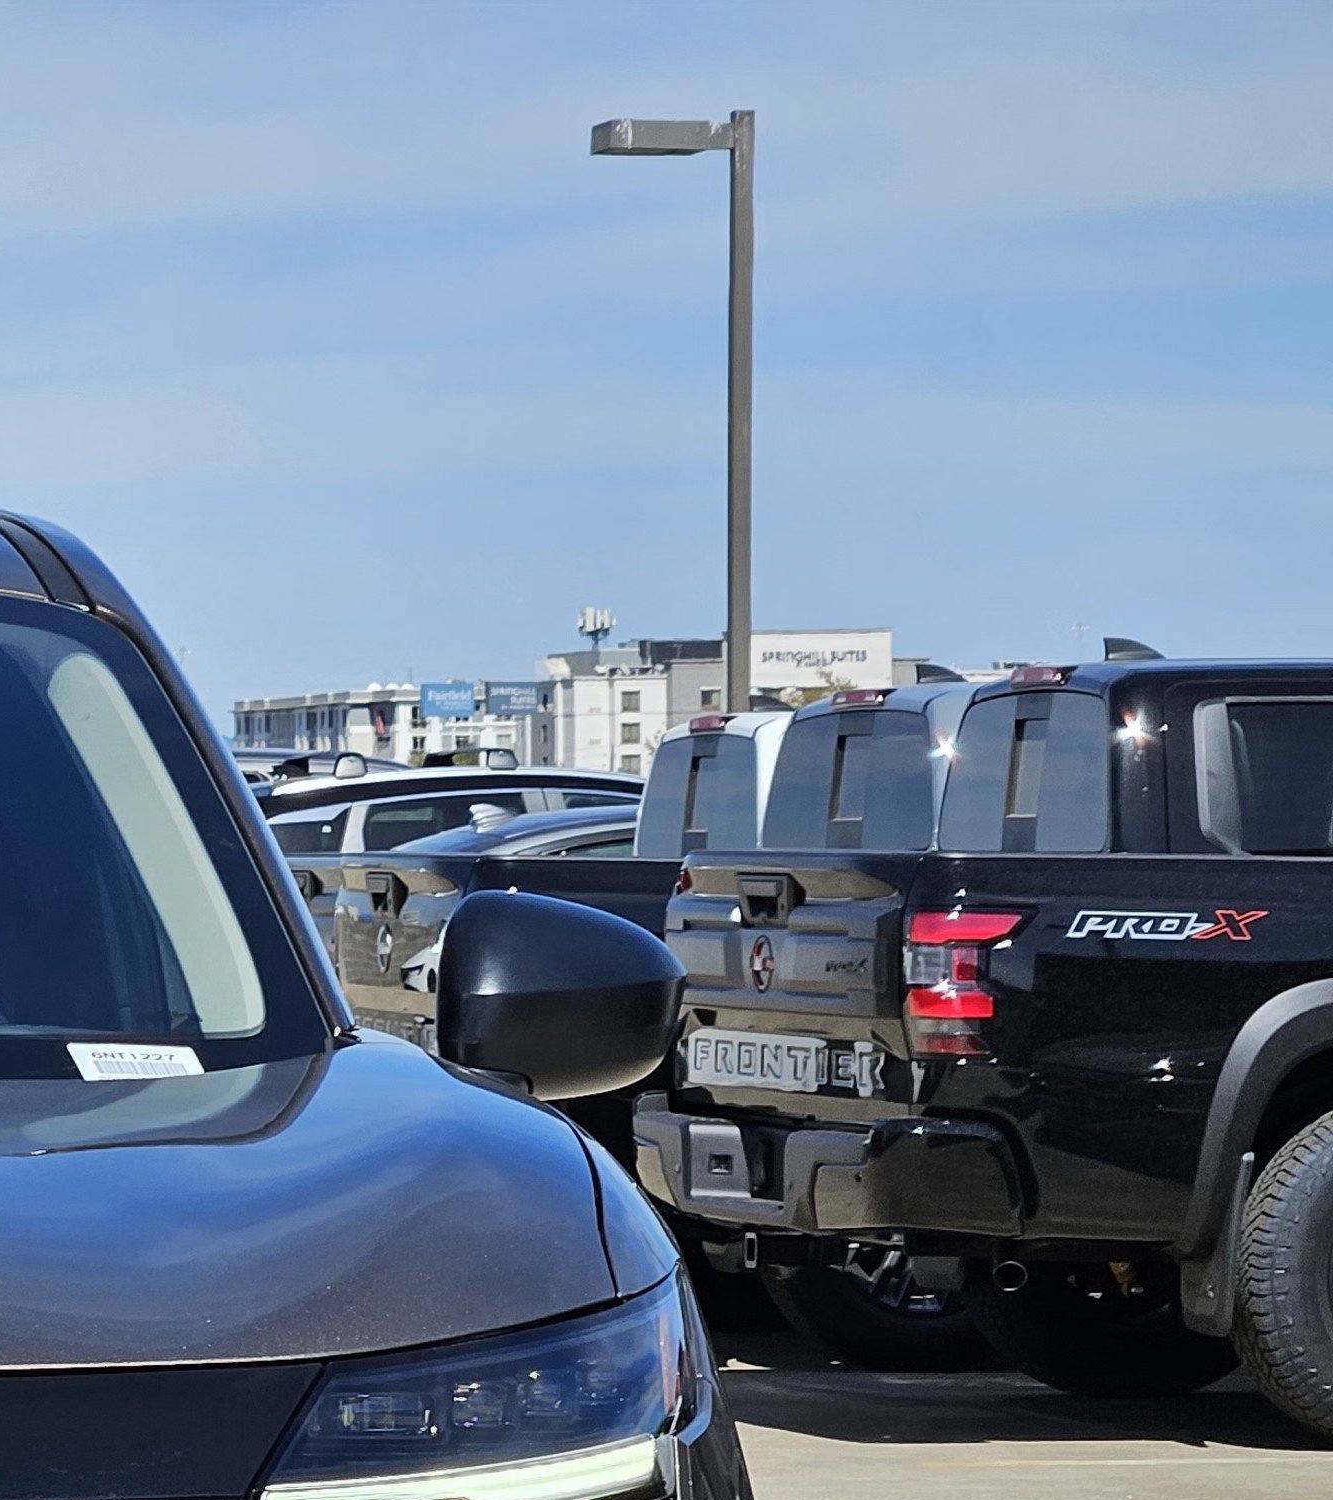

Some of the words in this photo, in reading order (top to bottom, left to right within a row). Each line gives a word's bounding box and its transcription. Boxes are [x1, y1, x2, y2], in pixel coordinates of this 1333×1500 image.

[762, 650, 826, 665] SPRINGHILL
[830, 650, 867, 662] SUITES
[693, 1037, 885, 1092] FRONTIER
